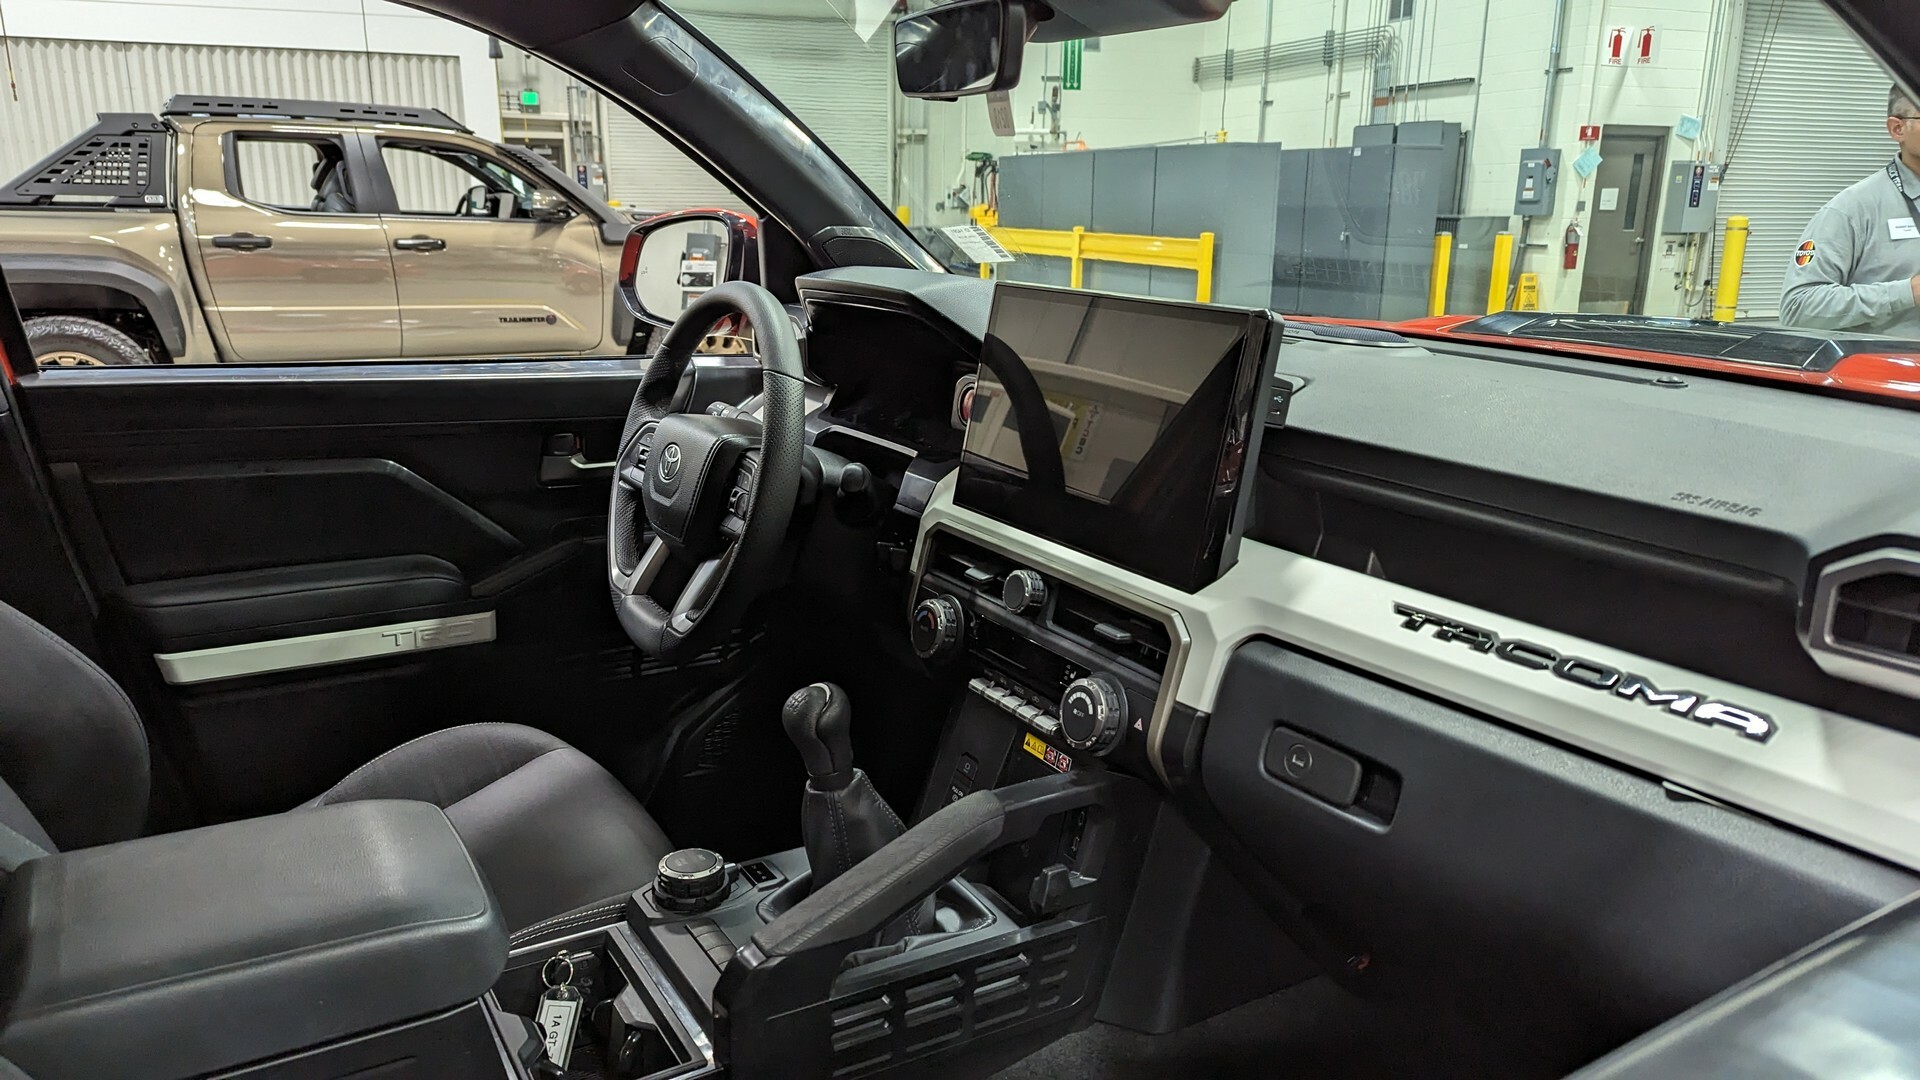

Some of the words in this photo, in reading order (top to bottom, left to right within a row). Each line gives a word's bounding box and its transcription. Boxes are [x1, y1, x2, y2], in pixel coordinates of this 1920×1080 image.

[382, 620, 477, 648] TRD
[1393, 601, 1778, 744] TACOMA
[551, 1015, 562, 1028] 1A
